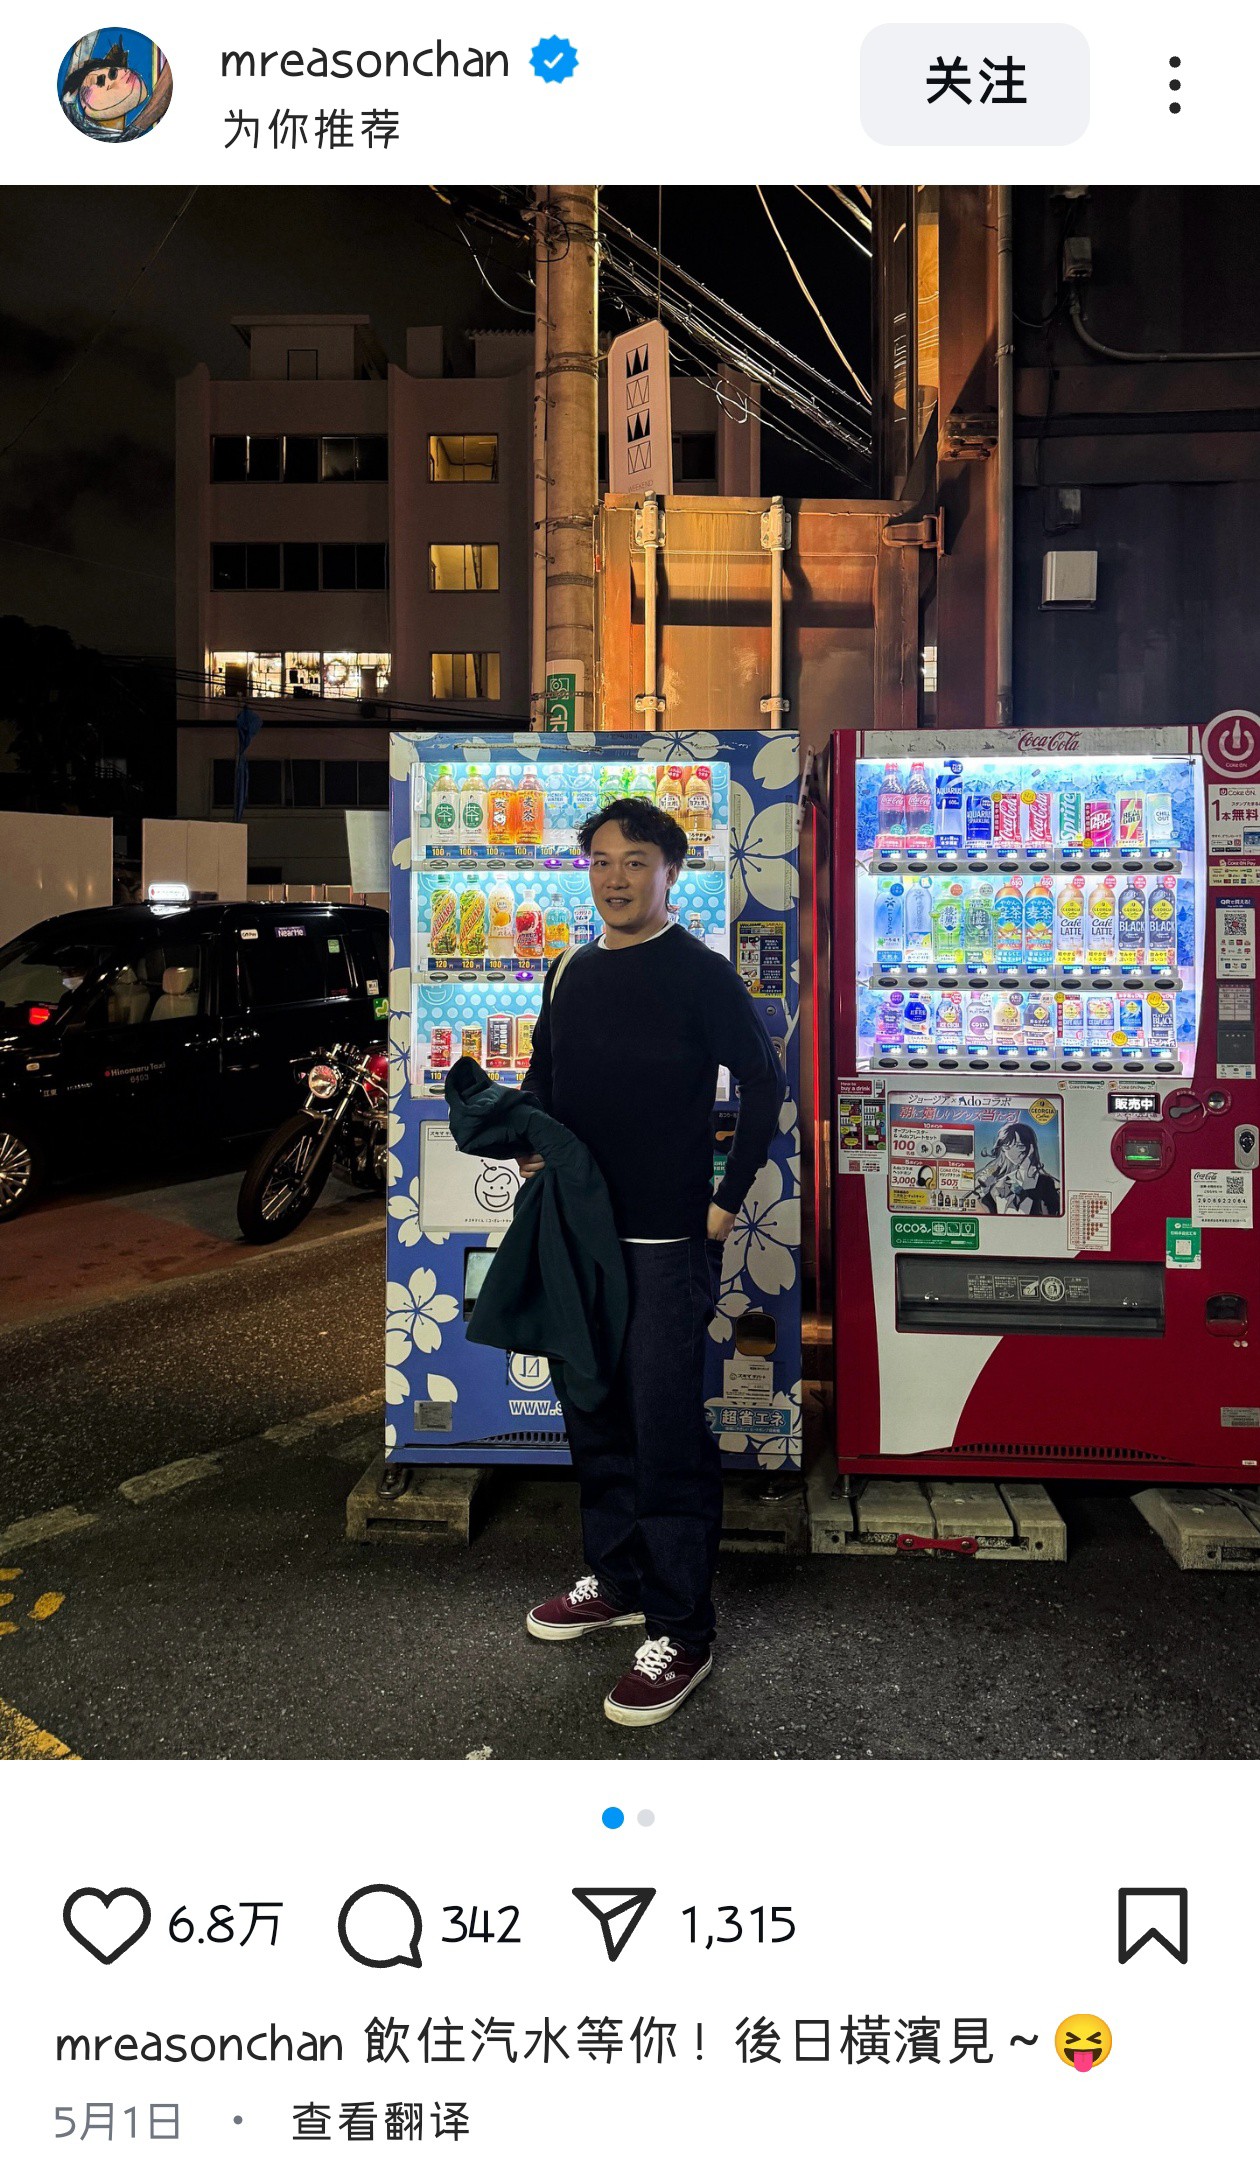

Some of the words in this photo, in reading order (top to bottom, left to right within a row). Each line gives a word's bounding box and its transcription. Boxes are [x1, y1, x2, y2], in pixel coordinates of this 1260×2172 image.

[936, 787, 962, 795] AQUARIUS
[1061, 793, 1077, 840] Sprite
[1026, 906, 1051, 919] 麦茶
[1061, 919, 1081, 927] Café
[1092, 919, 1112, 927] Café
[1120, 921, 1145, 932] BLACK
[1150, 921, 1175, 932] BLACK
[111, 1065, 149, 1076] Hinomaru
[150, 1061, 166, 1071] Taxi
[1115, 1098, 1153, 1110] 販売中
[893, 1140, 915, 1150] 100
[892, 1176, 916, 1185] 3,000
[941, 1178, 958, 1187] 50万
[721, 1409, 785, 1426] 超省エネ
